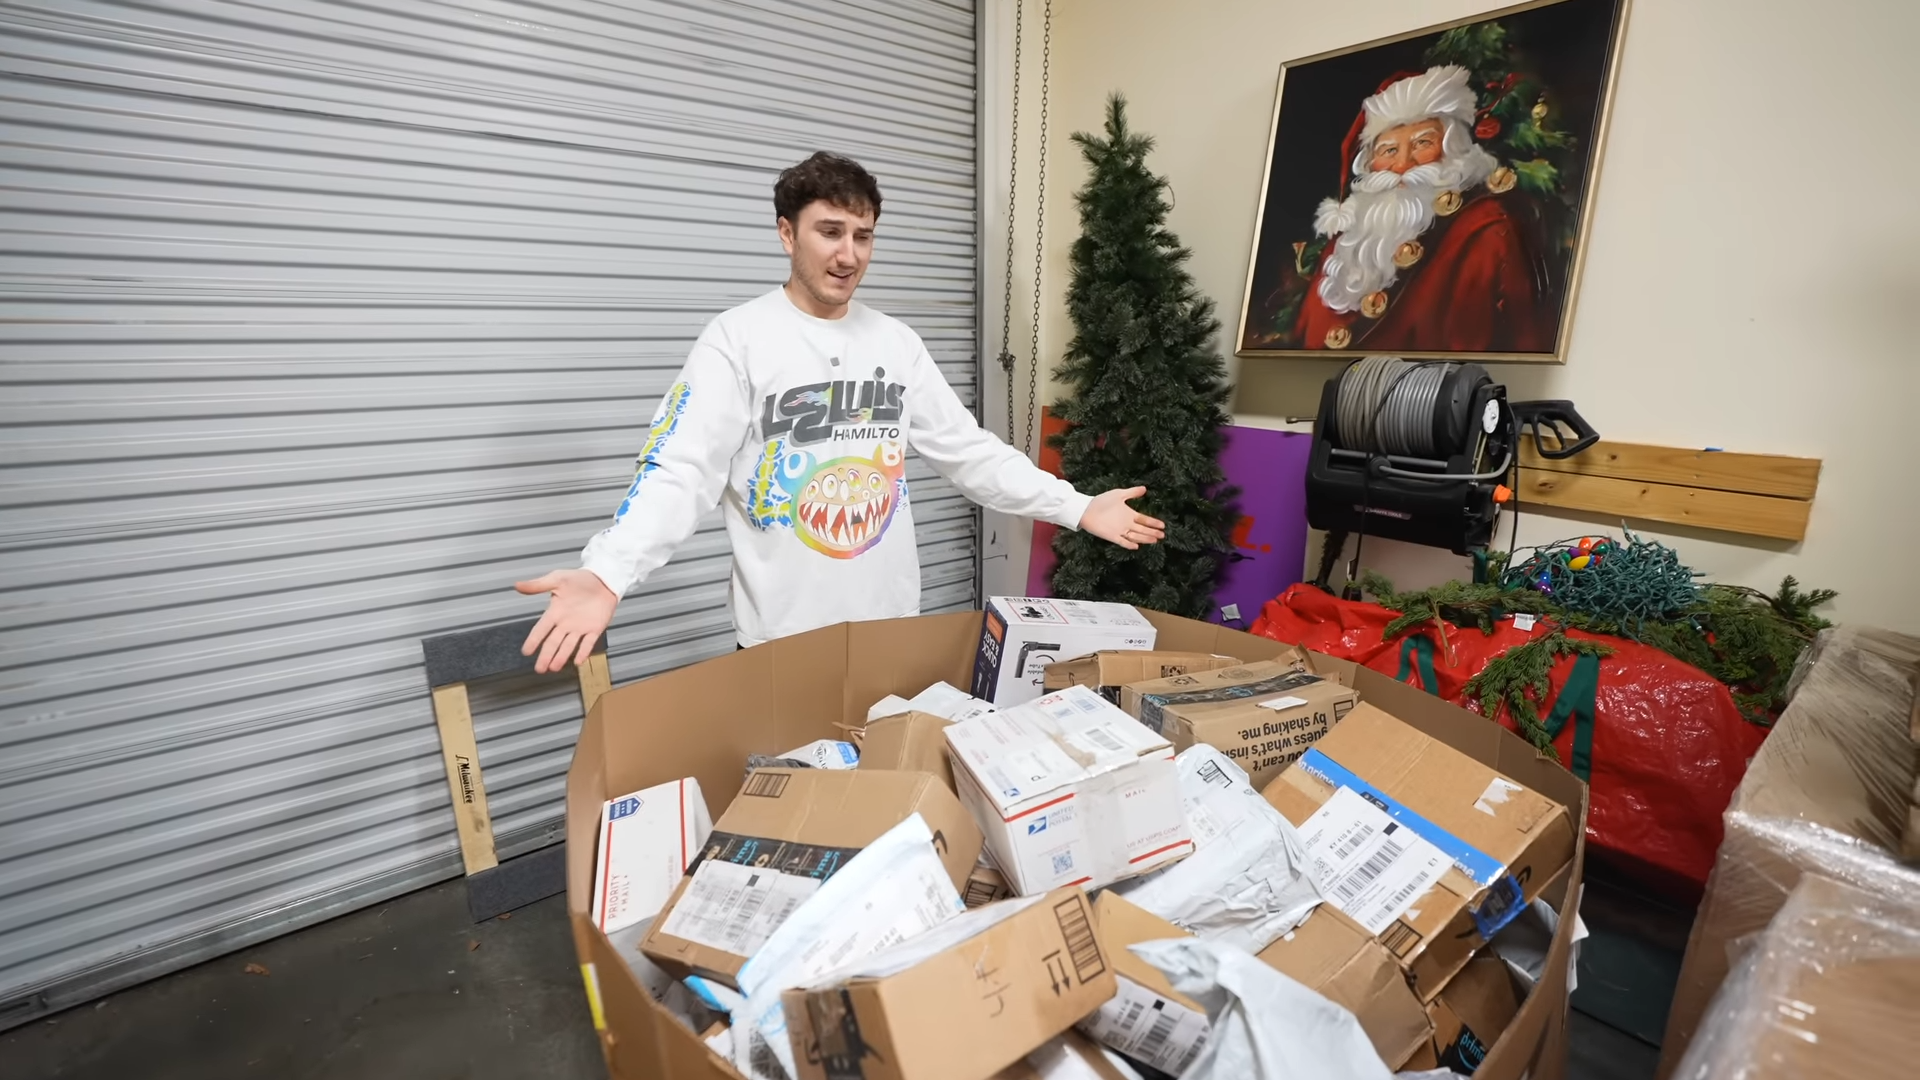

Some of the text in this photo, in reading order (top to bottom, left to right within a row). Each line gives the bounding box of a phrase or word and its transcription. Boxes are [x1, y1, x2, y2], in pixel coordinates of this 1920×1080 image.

[833, 427, 900, 442] HAMILTO
[1237, 711, 1328, 741] by shaking me.
[1220, 726, 1328, 760] guess what's insi
[1252, 754, 1286, 772] can't
[458, 761, 475, 804] Milwaukee
[730, 838, 752, 864] ime
[809, 850, 834, 878] ime
[1453, 857, 1475, 878] ime
[608, 873, 620, 920] PRIORITY
[622, 880, 630, 906] MAIL
